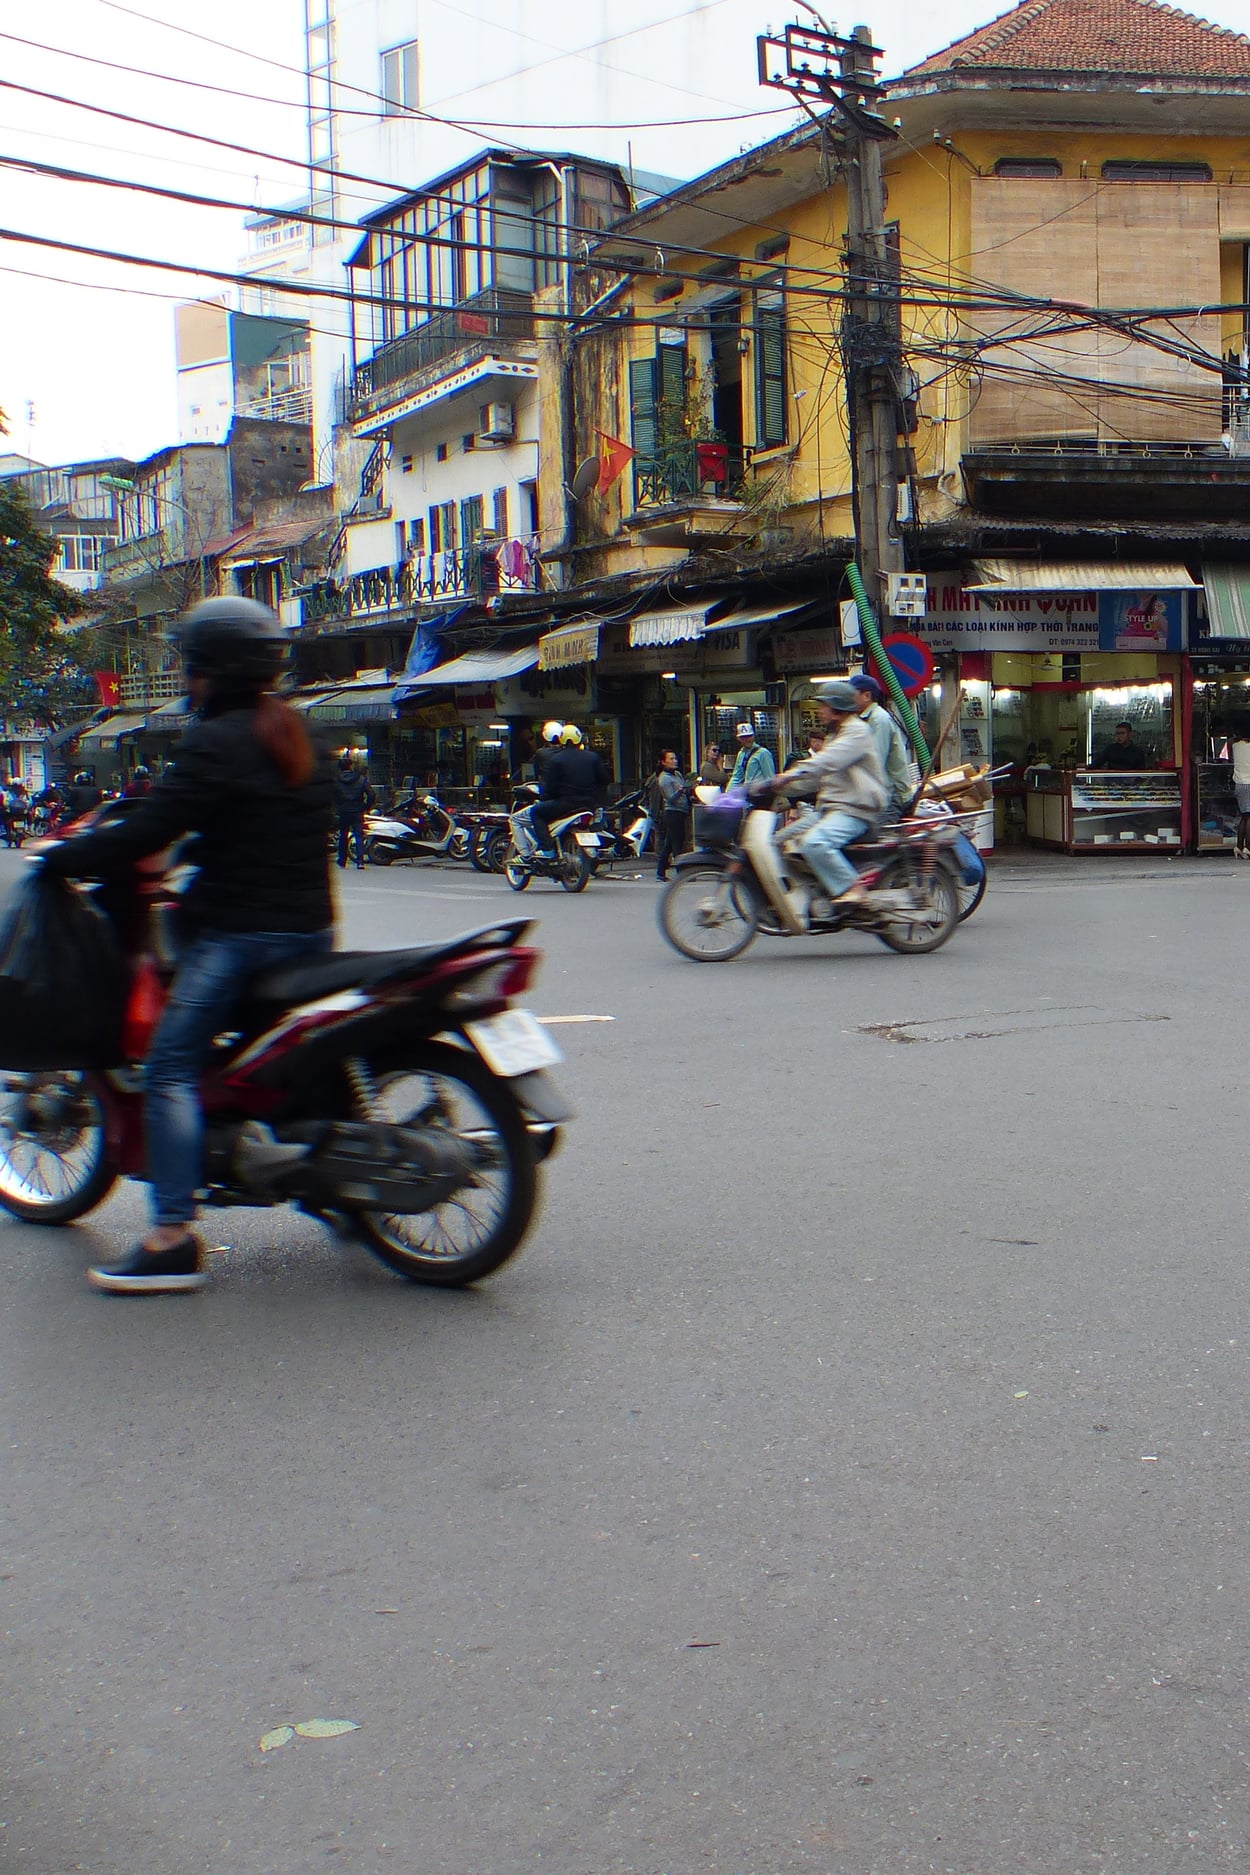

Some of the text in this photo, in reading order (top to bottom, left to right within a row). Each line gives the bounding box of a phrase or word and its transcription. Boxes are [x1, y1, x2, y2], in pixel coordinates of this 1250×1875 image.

[945, 620, 964, 632] CÁC
[966, 622, 987, 634] LOẠI
[989, 620, 1015, 632] KÍNH
[1066, 622, 1099, 632] TRANG
